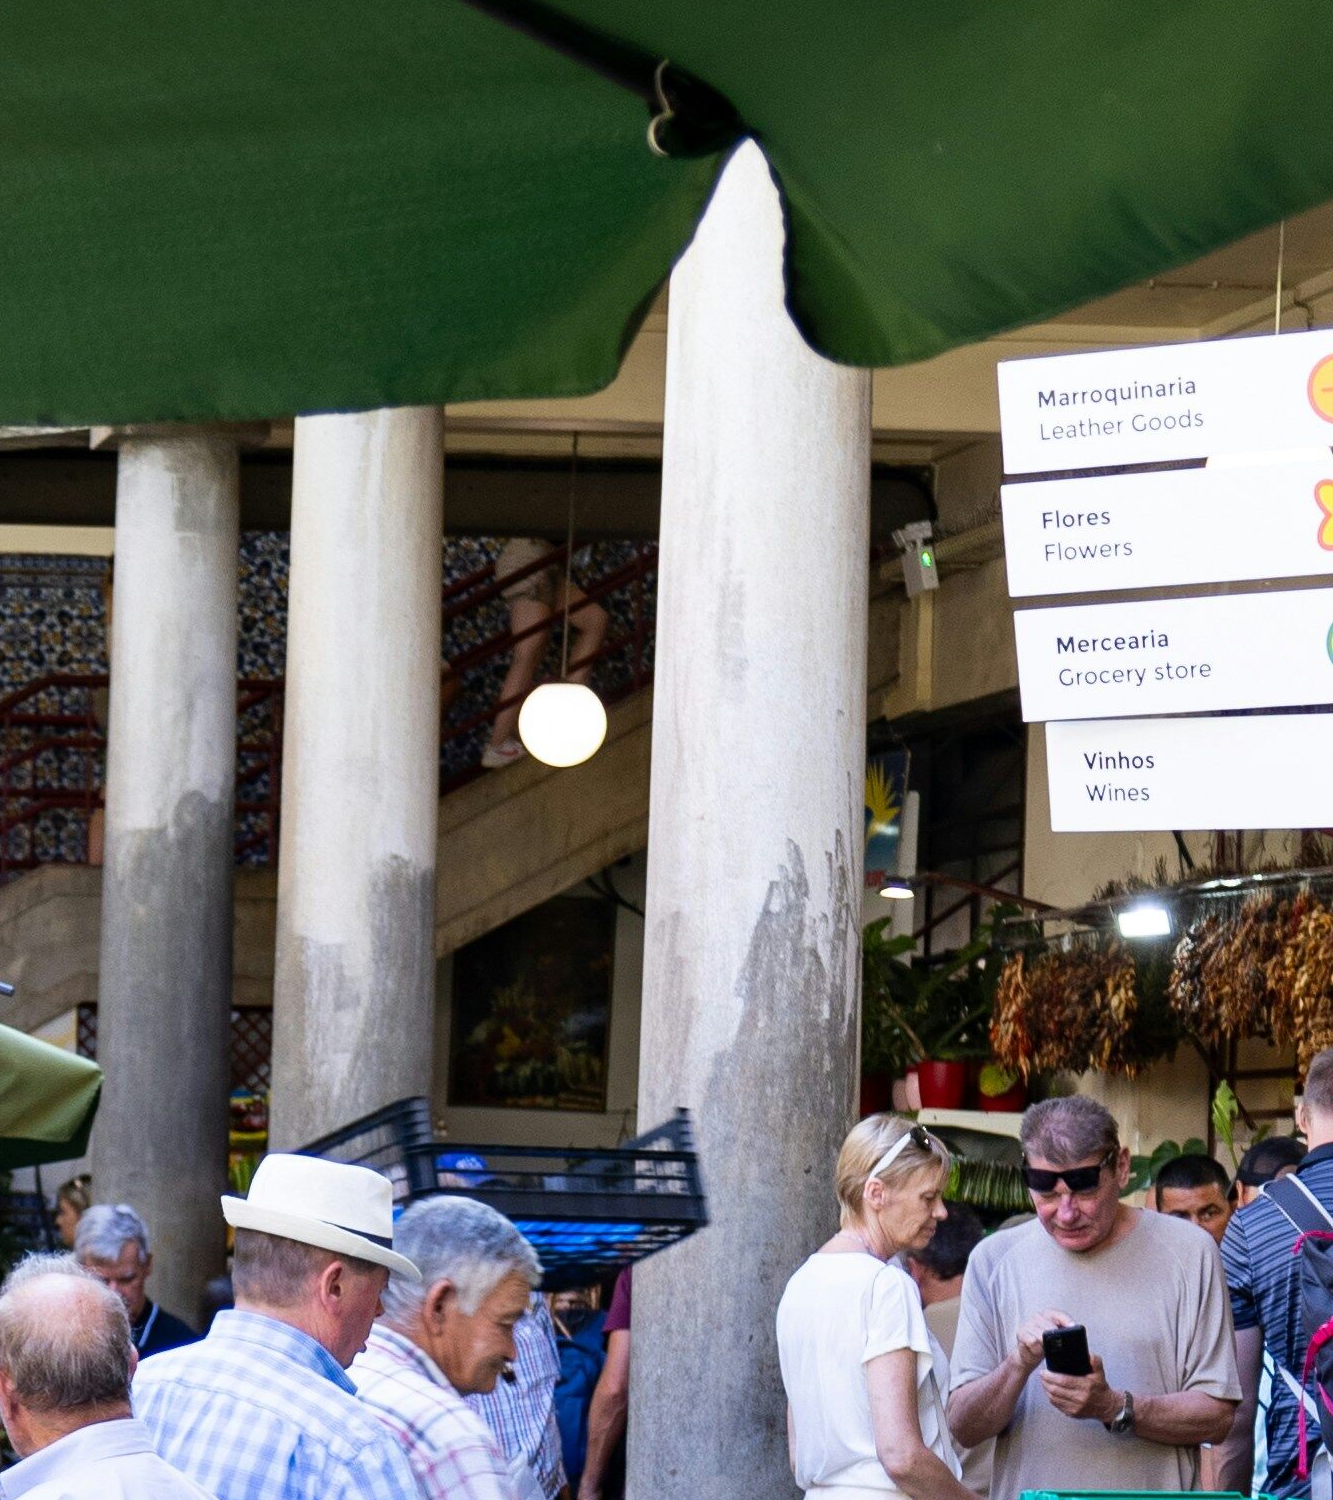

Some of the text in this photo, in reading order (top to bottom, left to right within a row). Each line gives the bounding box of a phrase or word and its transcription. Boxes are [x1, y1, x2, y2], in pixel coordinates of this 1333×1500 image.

[1038, 377, 1195, 408] Marroquinaria
[1041, 410, 1203, 440] Leather Goods
[1042, 510, 1110, 529] Flores
[1045, 543, 1132, 561] Flowers
[1057, 630, 1168, 654] Mercearia
[1059, 663, 1211, 686] Grocery store
[1084, 751, 1154, 769] Vinhos
[1086, 783, 1149, 801] Wines
